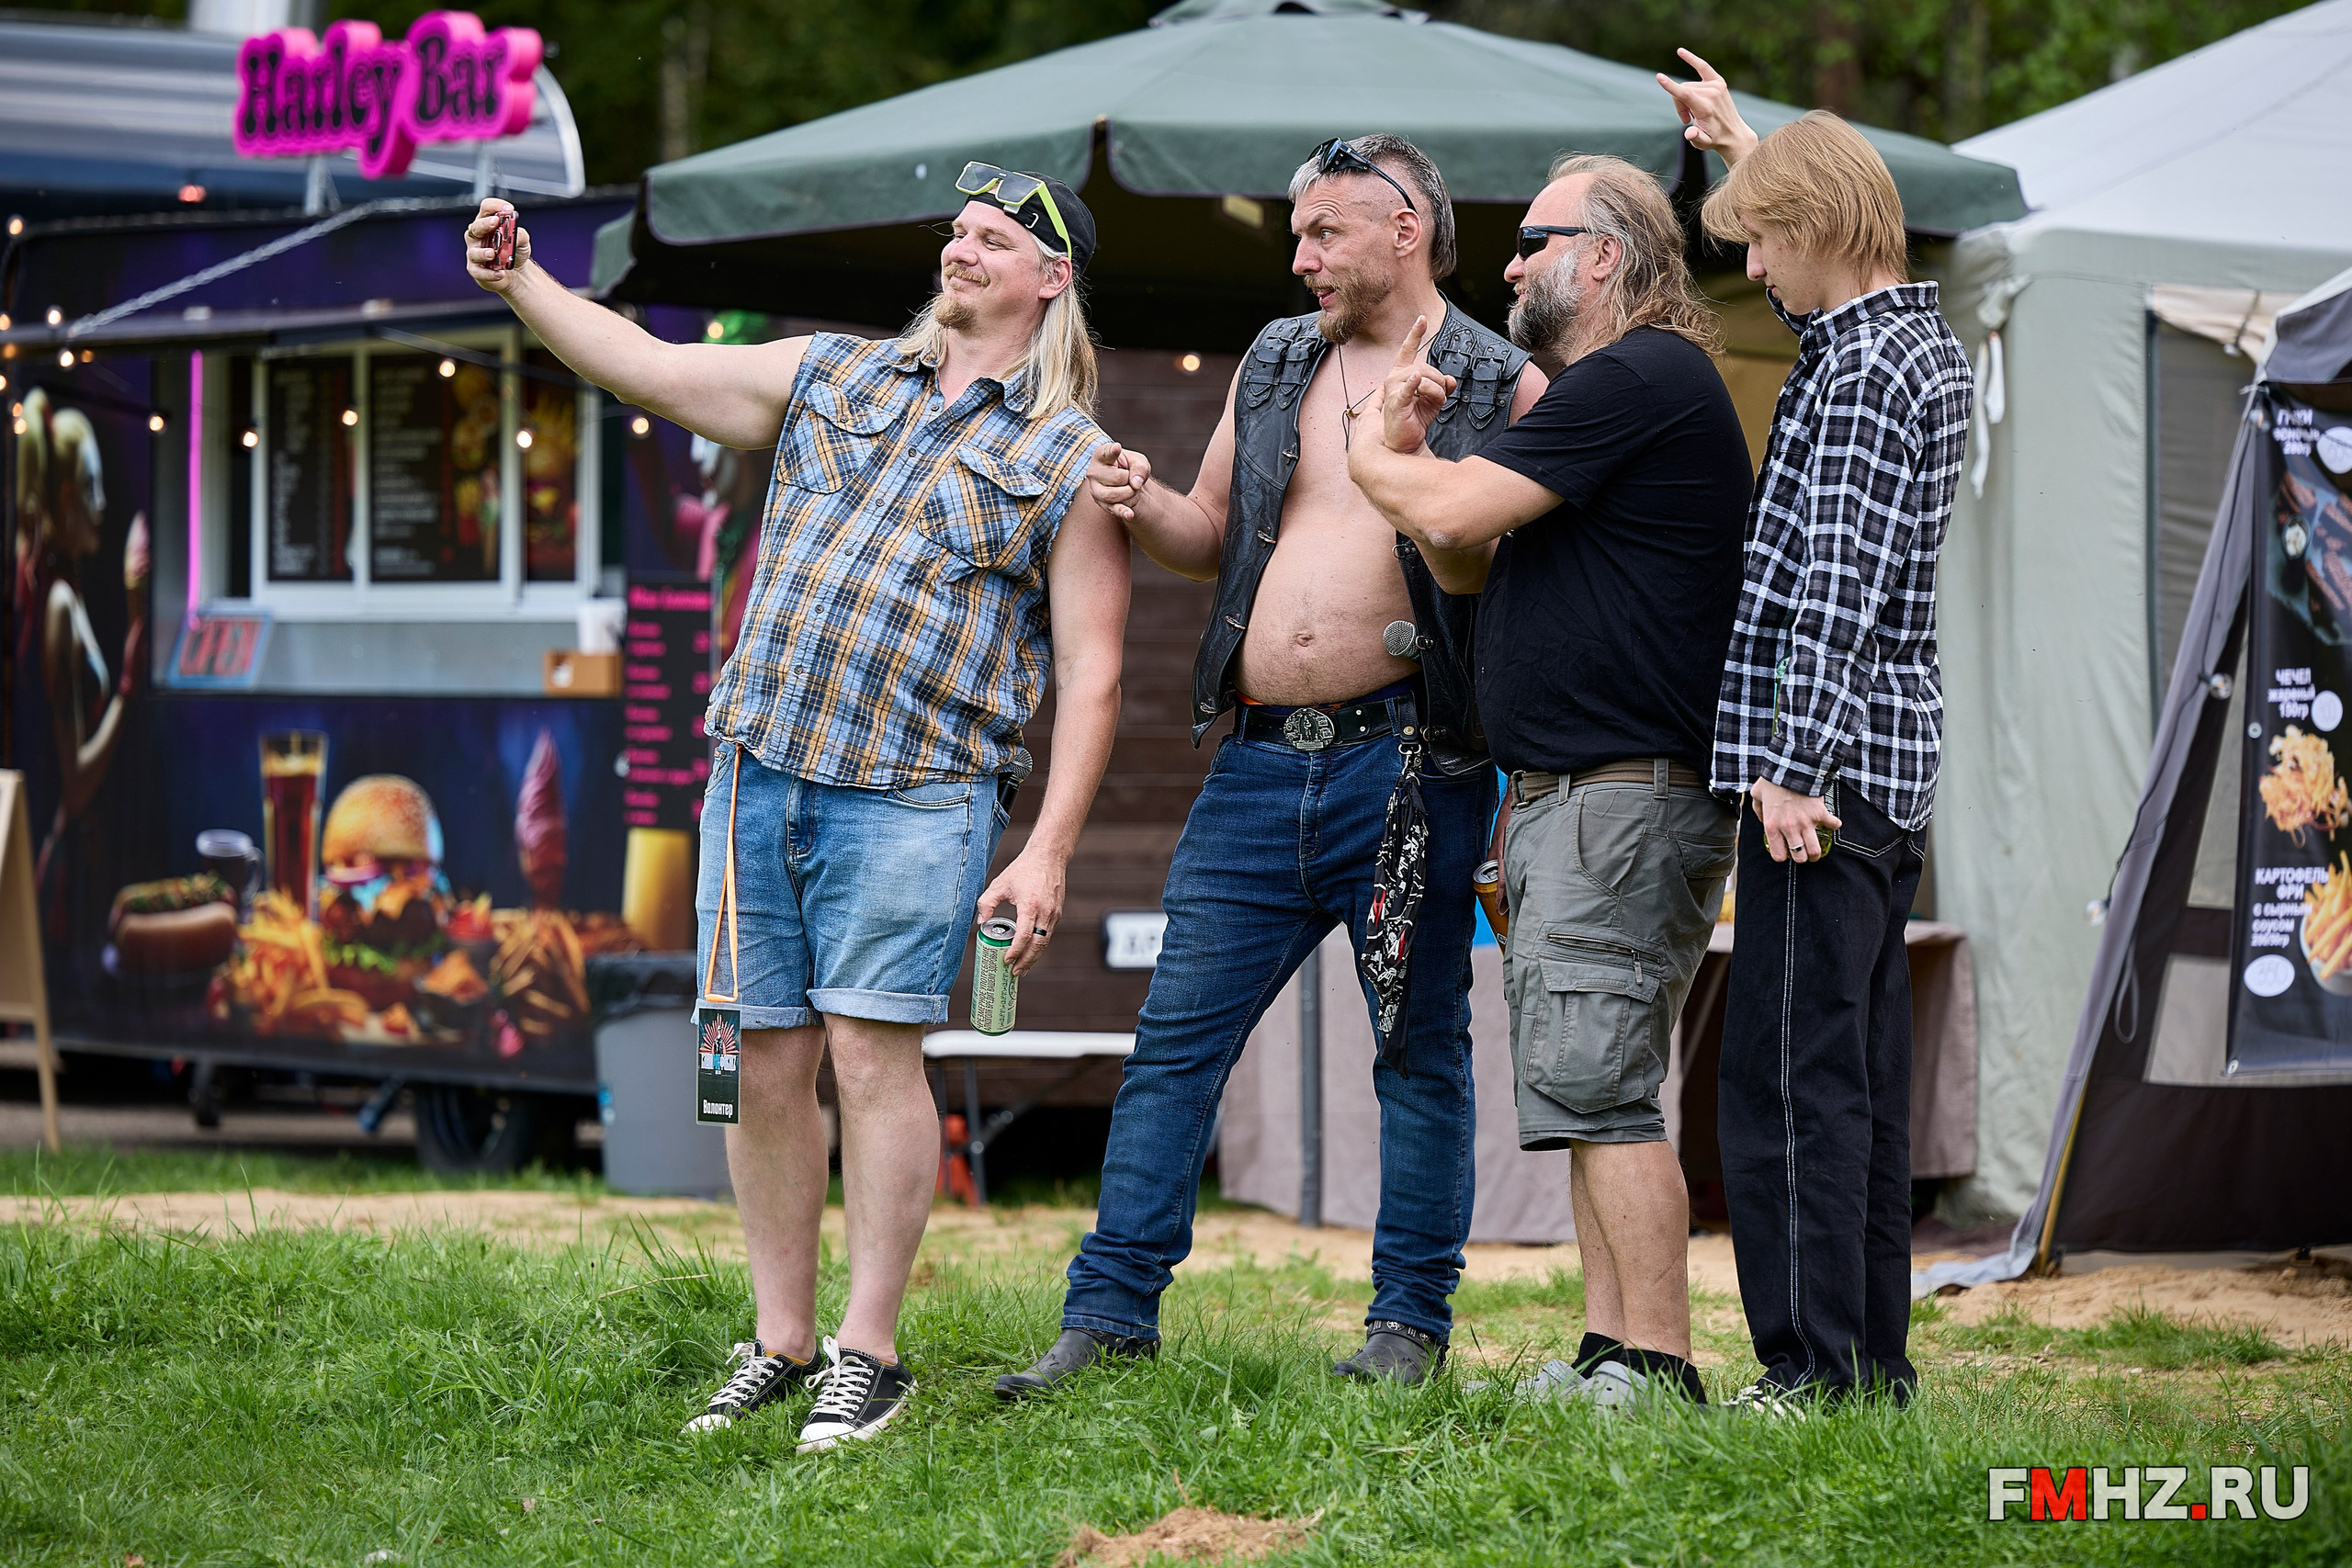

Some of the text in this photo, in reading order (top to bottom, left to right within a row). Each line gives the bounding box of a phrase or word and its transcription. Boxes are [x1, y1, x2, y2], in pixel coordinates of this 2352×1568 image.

[243, 35, 507, 156] Harley Bar
[2275, 667, 2312, 686] ЧЕЧЕЛ
[2267, 683, 2316, 704] жареный
[2255, 866, 2329, 885] КАРТОФЕЛЬ
[2276, 883, 2305, 900] ФРИ
[2263, 902, 2313, 919] сырным
[2252, 919, 2295, 935] соусом
[977, 945, 990, 1029] ЧРЕЗМЕРНОЕ УПОТРЕБЛЕНИЕ
[703, 1100, 734, 1118] Волонтер
